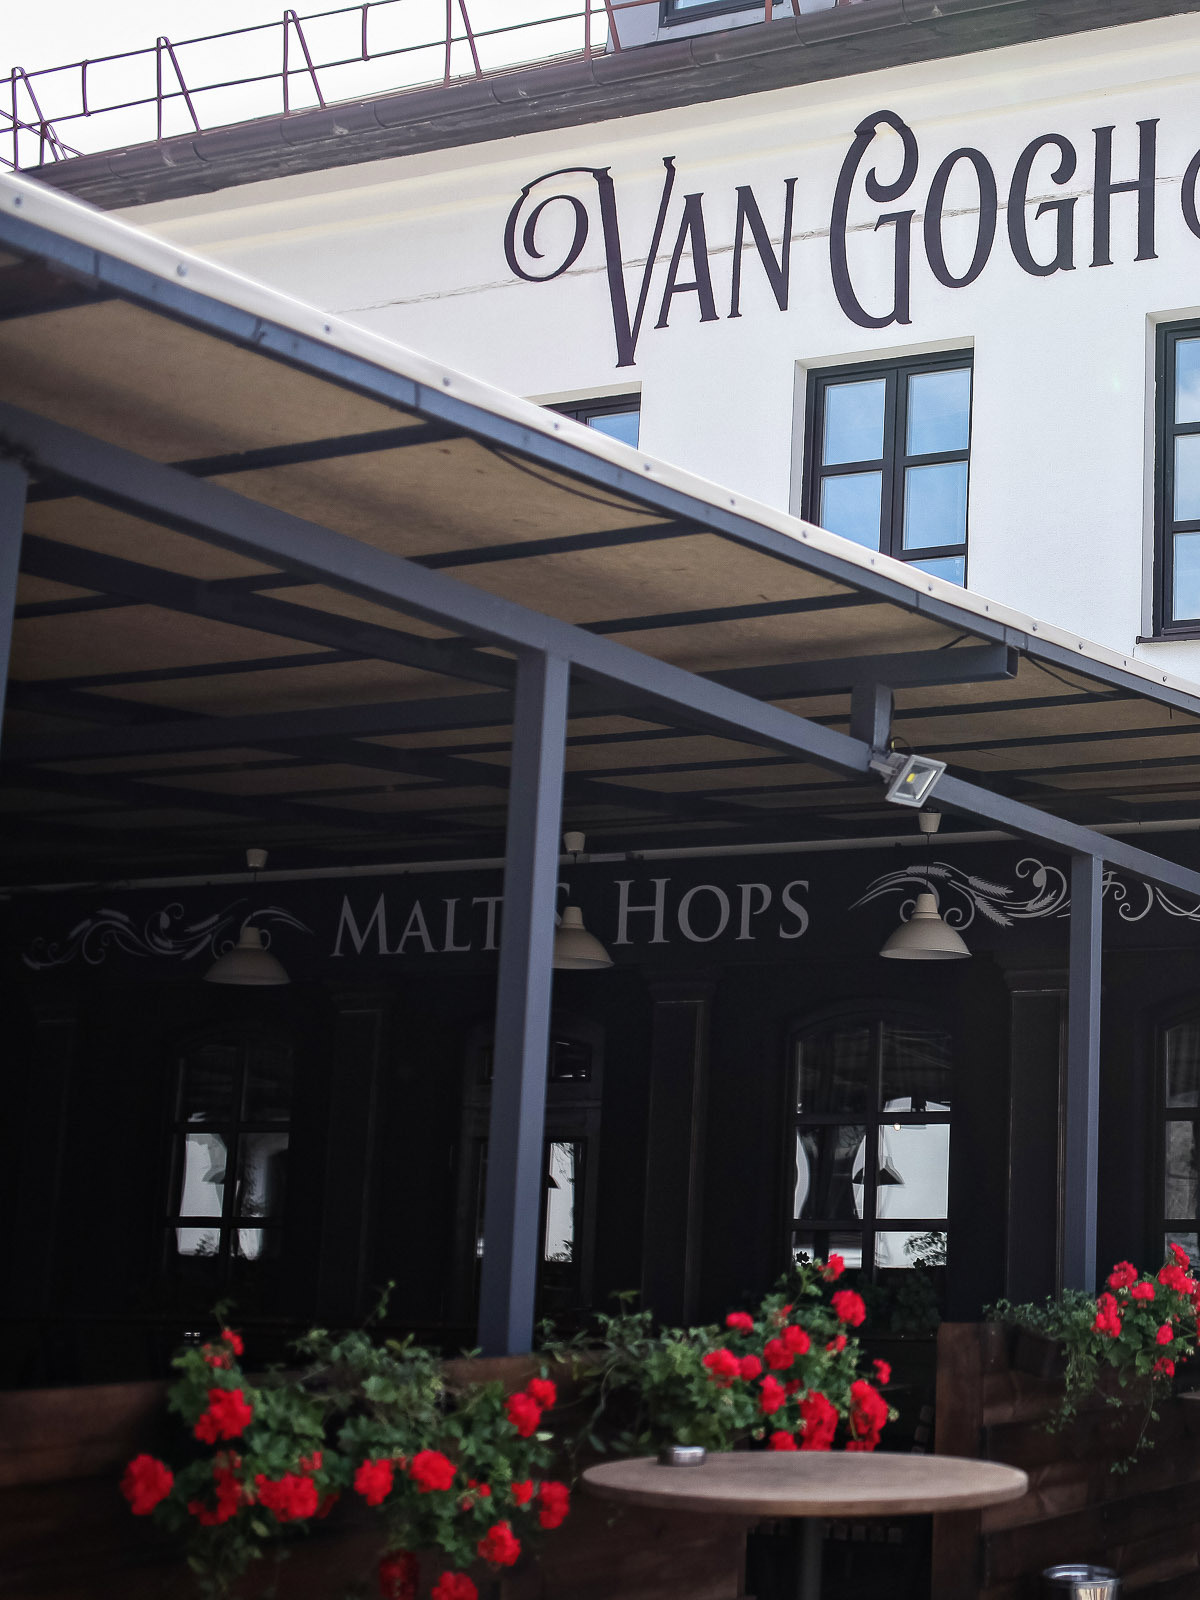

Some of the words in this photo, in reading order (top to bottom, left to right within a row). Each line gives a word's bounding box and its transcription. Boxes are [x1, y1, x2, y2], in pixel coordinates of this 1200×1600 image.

[503, 155, 799, 368] VAN
[828, 109, 1161, 329] GOGH
[612, 878, 810, 945] HOPS
